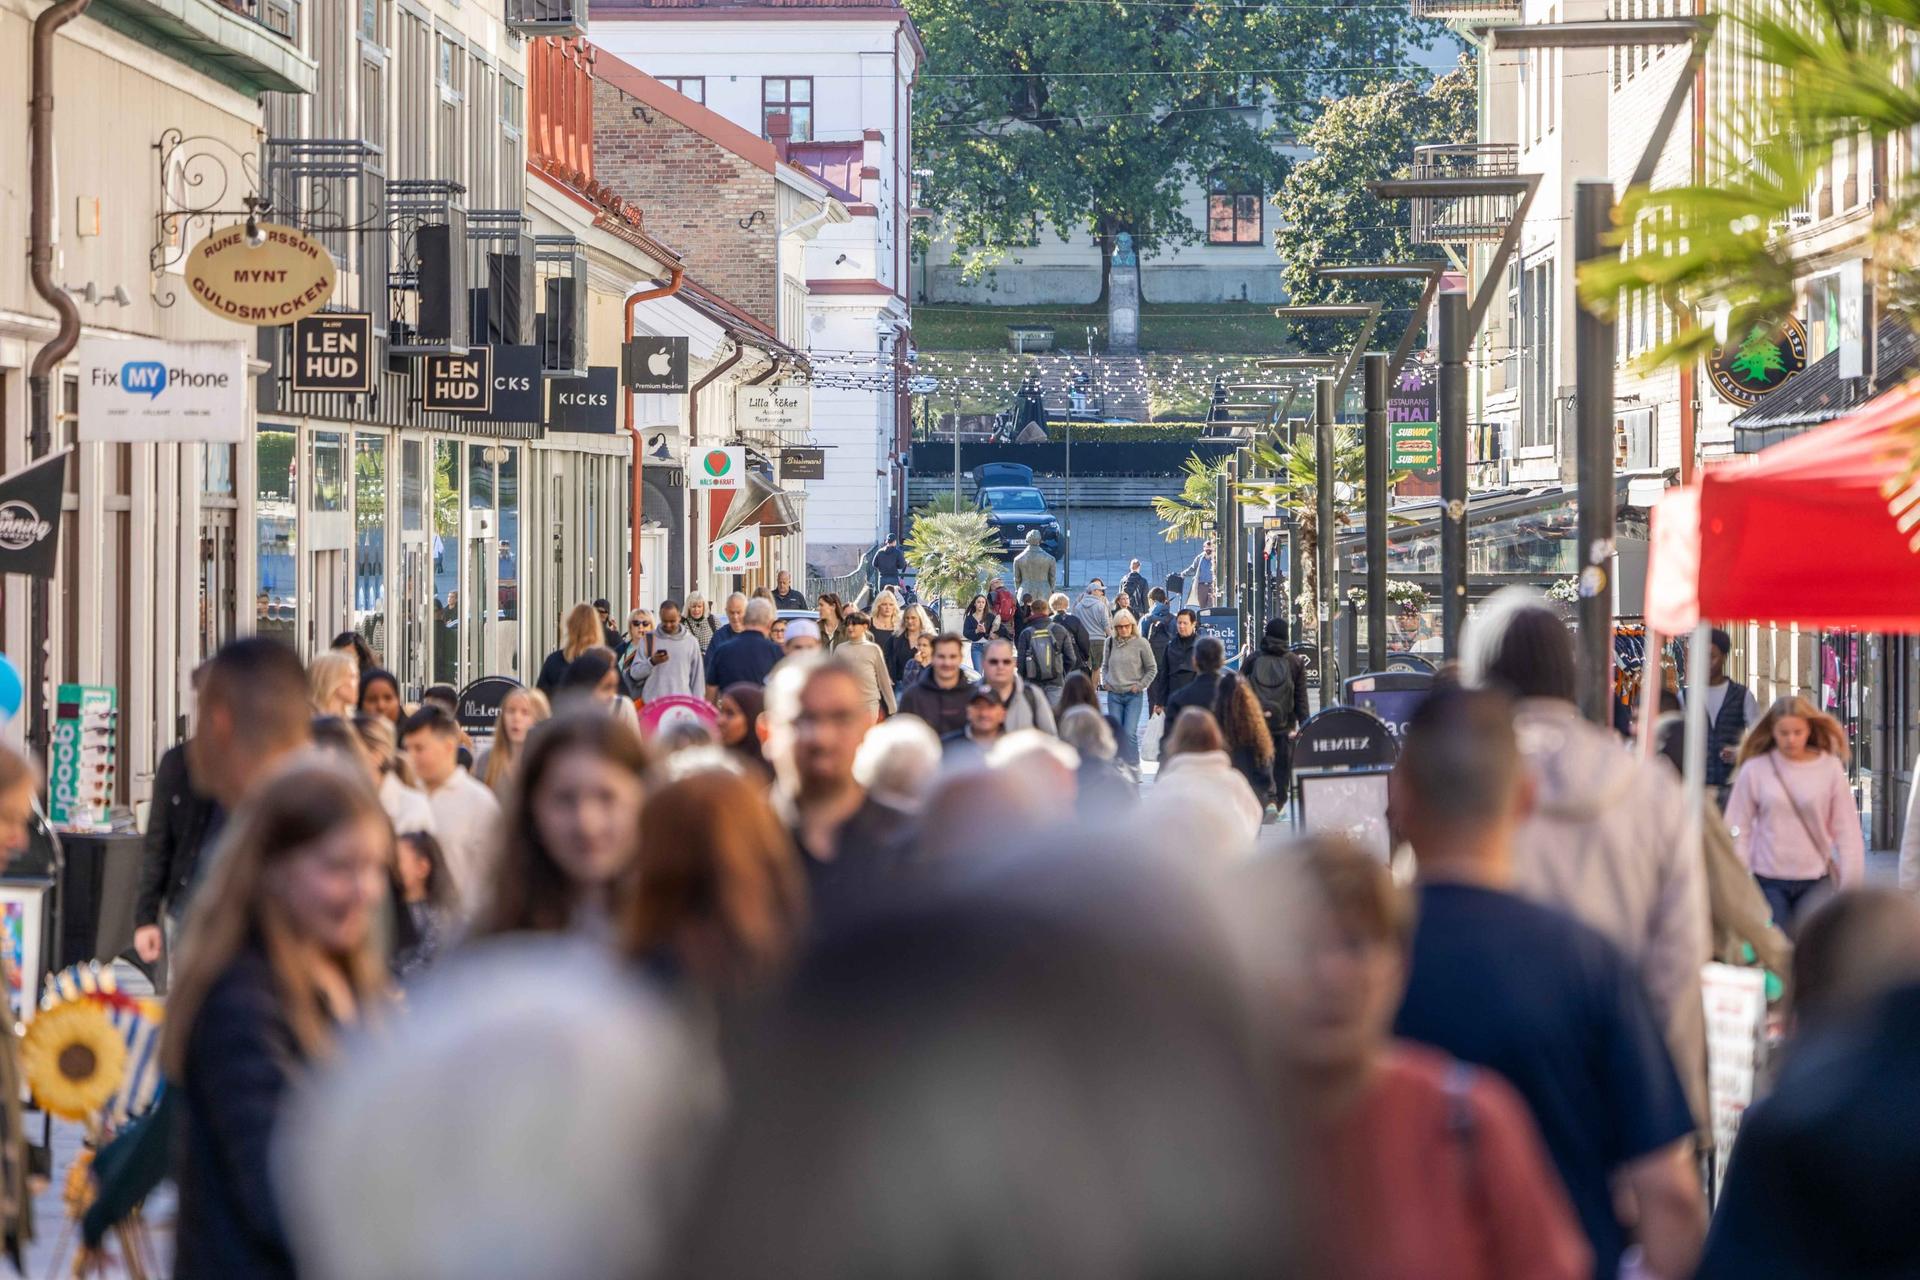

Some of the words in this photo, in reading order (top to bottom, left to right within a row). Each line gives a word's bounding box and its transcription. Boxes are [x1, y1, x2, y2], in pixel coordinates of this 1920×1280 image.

[203, 233, 243, 258] RUNE
[268, 231, 319, 259] RSSON
[234, 270, 288, 282] MYNT
[192, 276, 328, 320] GULDSMYCKEN
[306, 332, 357, 353] LEN
[306, 357, 358, 378] HUD
[436, 361, 478, 378] LEN
[92, 368, 118, 386] Fix
[127, 367, 160, 388] MY
[169, 368, 228, 387] Phone
[494, 377, 530, 391] CKS
[435, 382, 479, 400] HUD
[559, 393, 608, 406] KICKS
[749, 398, 769, 408] Lilla
[1388, 407, 1429, 421] THAI
[1396, 428, 1432, 437] SUBWAY
[1396, 455, 1432, 464] SUBWAY
[669, 470, 683, 487] 10
[1207, 627, 1235, 638] Tack
[53, 723, 75, 825] goodr
